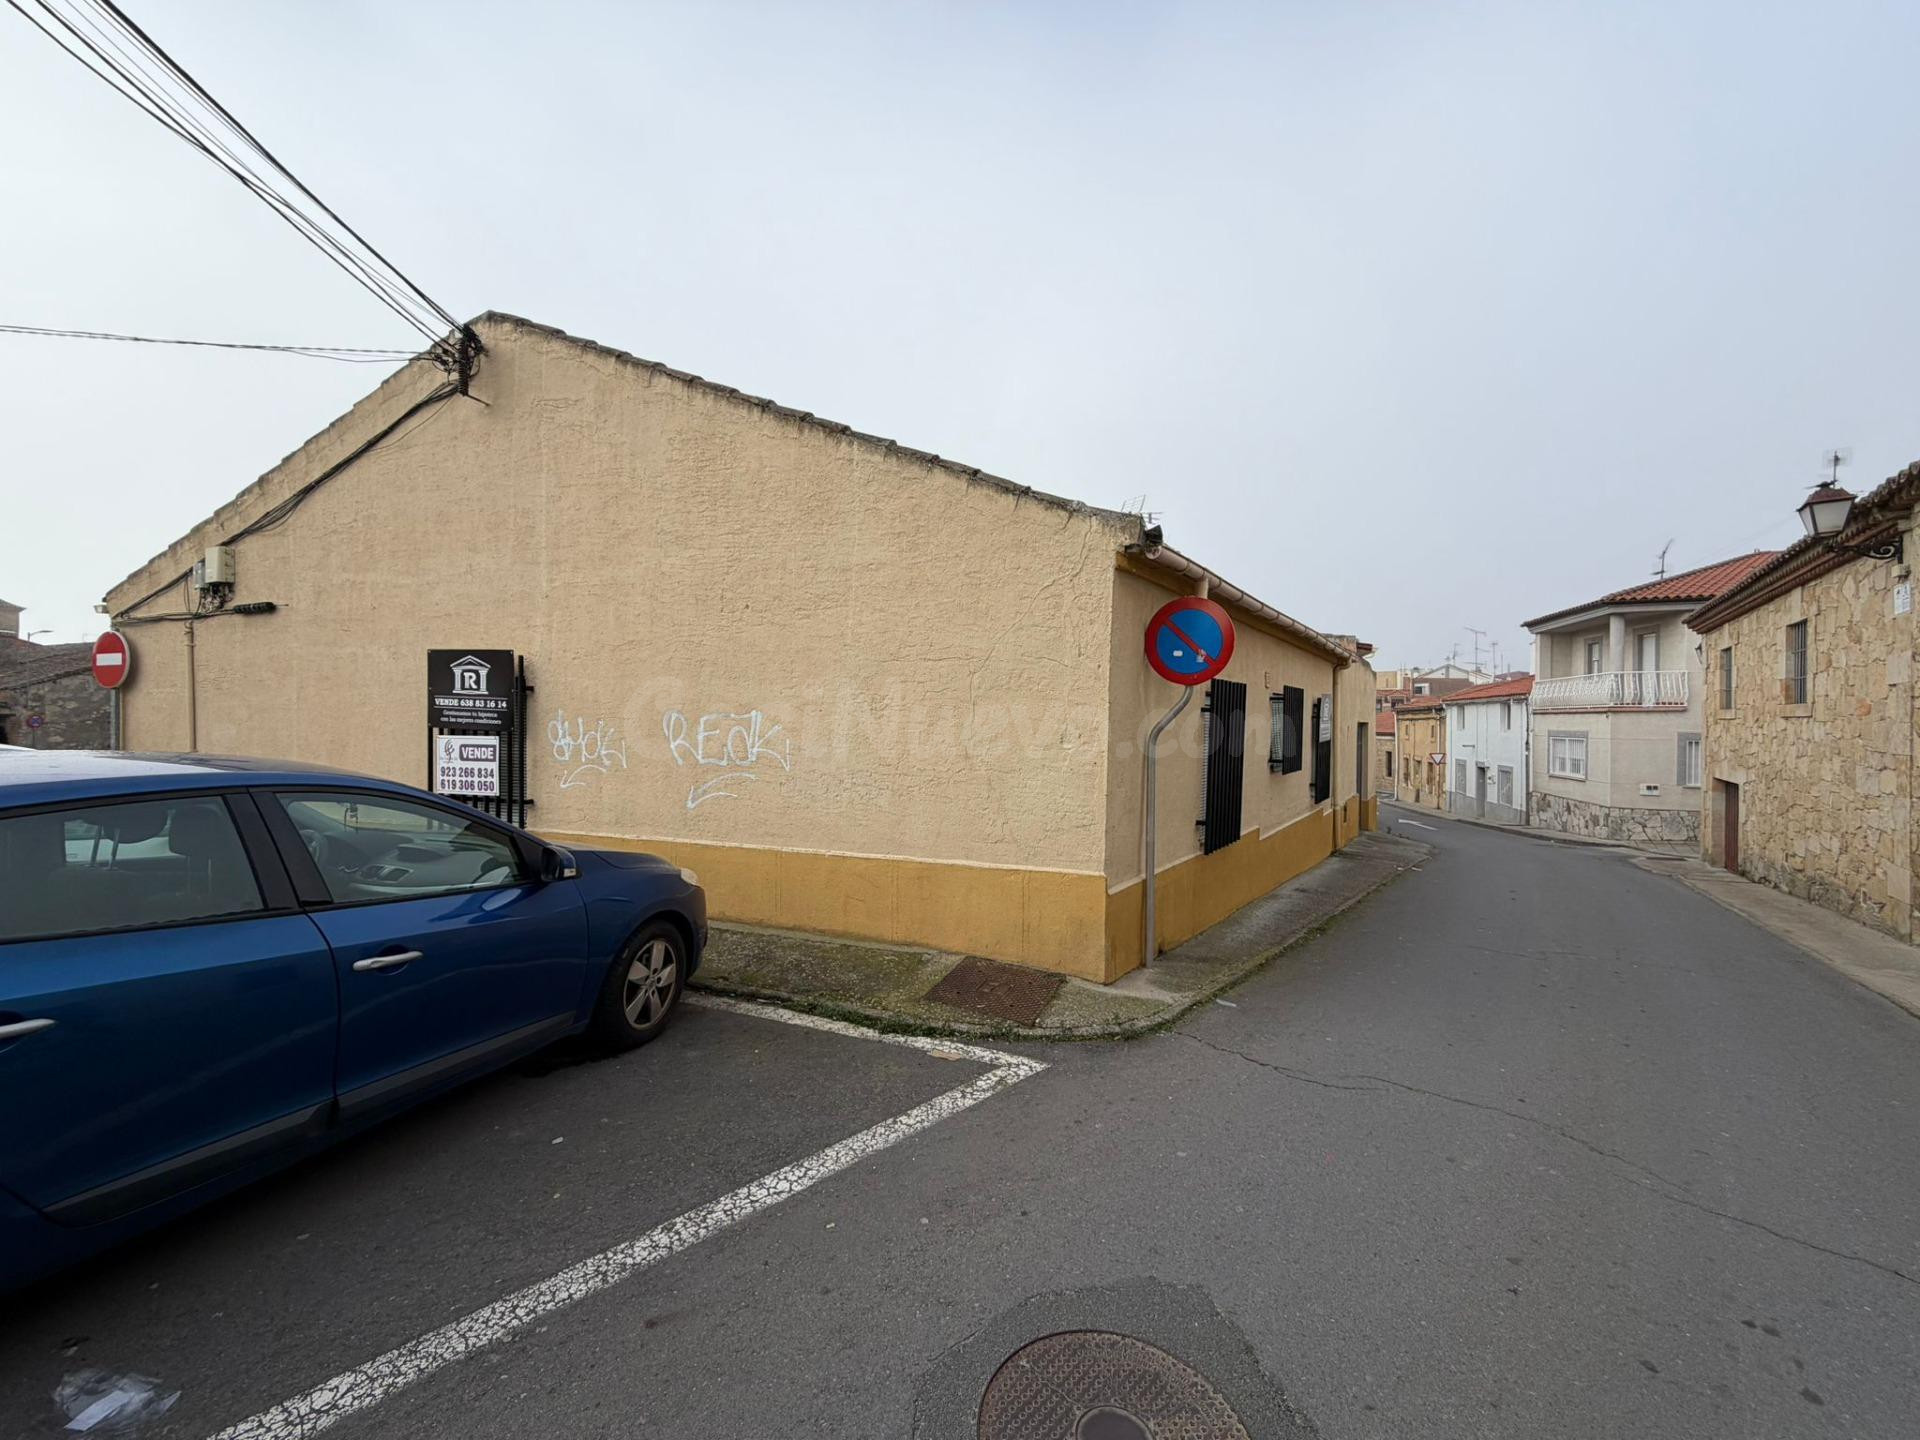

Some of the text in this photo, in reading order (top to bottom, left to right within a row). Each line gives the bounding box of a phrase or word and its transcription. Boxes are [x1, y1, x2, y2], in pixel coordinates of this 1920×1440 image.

[463, 672, 478, 689] R
[434, 698, 507, 708] VENDE 638 83 16 14
[461, 747, 494, 759] VENDE
[440, 766, 494, 779] 923 266 834
[440, 779, 495, 792] 619 306 050
